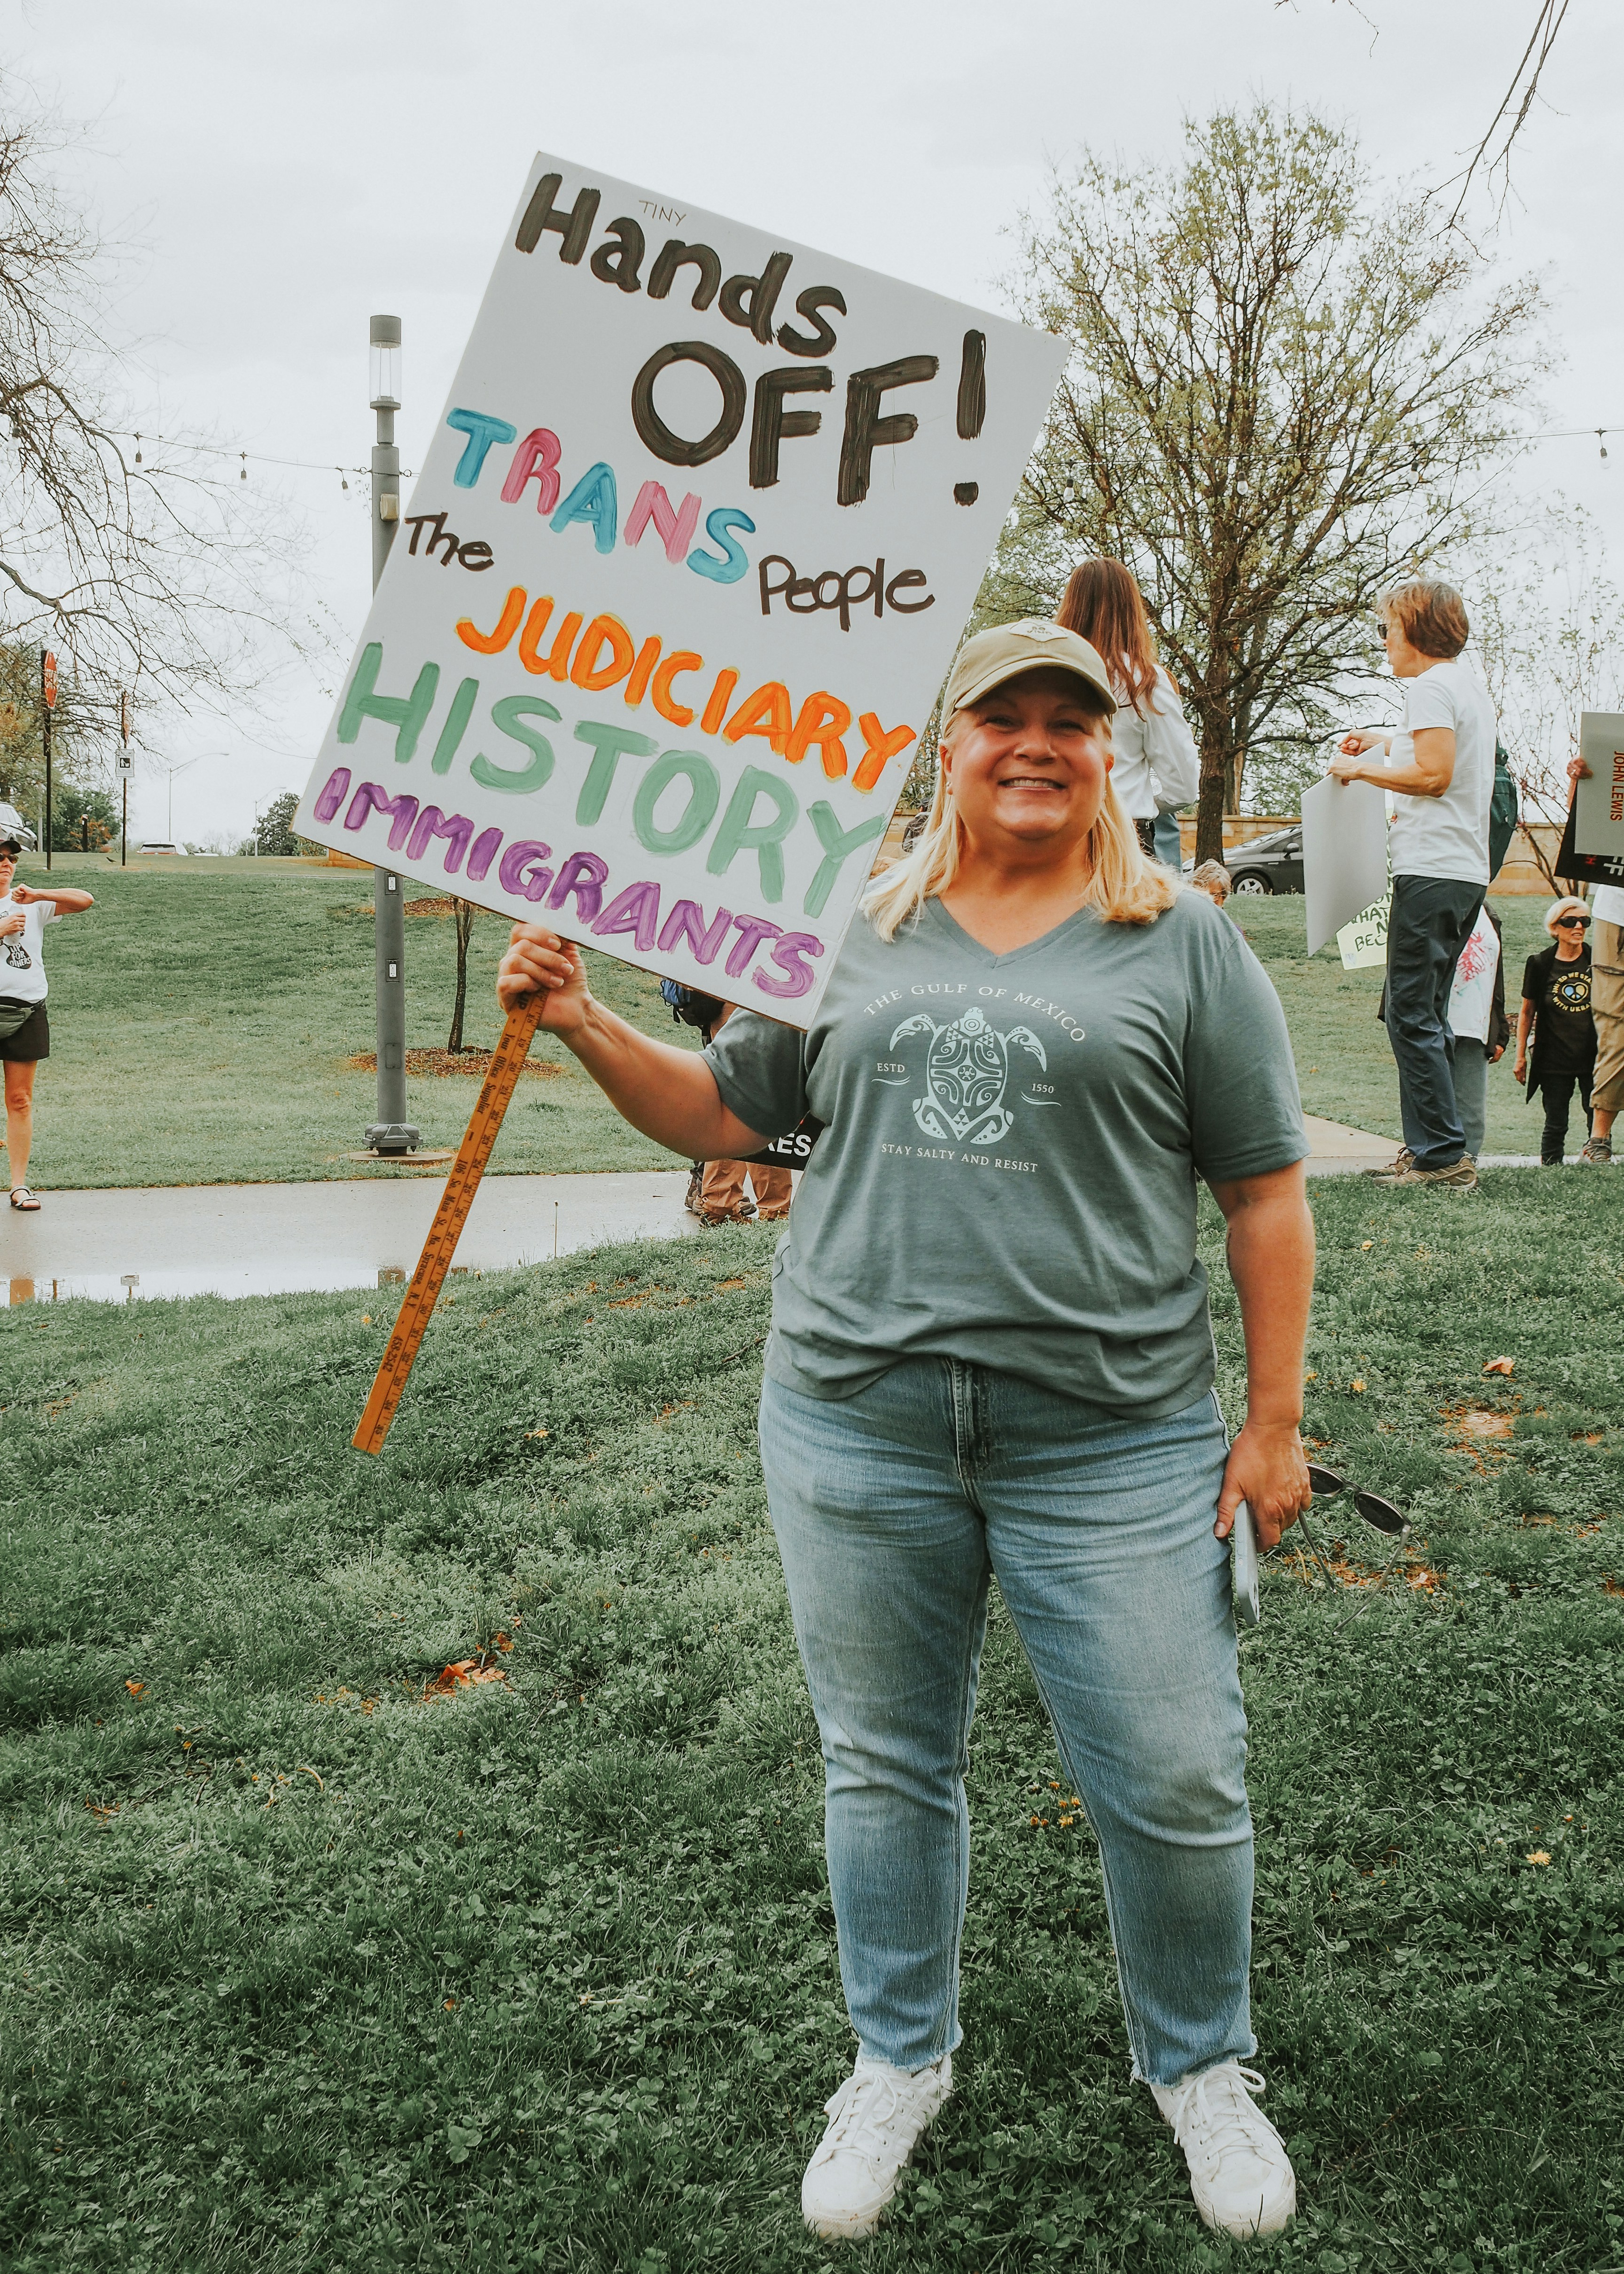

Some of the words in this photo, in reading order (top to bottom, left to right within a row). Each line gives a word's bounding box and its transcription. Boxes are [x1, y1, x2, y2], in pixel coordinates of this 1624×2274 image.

[639, 200, 687, 227] TINY
[515, 173, 847, 357] Hands
[632, 329, 986, 507] OFF!
[446, 408, 757, 584] TRANS
[759, 555, 935, 632] People
[405, 512, 494, 571] The
[456, 586, 917, 793] JUDICIARY
[337, 642, 886, 918] HISTORY
[1613, 751, 1624, 785] JOHN
[1610, 785, 1624, 821] LEWIS
[314, 767, 825, 999] IMMIGRANTS
[10, 957, 31, 968] OTHERS
[11, 951, 26, 960] FOR
[863, 989, 902, 1016] THE
[911, 983, 968, 996] GULF
[978, 986, 1007, 998] OF
[1013, 992, 1086, 1043] MEXICO
[501, 1034, 515, 1051] Your
[518, 1038, 526, 1048] 19
[491, 1056, 506, 1078] Office
[509, 1061, 517, 1072] 20
[877, 1063, 905, 1074] ESTD
[477, 1083, 496, 1114] Supplier
[1031, 1083, 1054, 1094] 1550
[455, 1160, 468, 1174] 106
[881, 1143, 912, 1155] STAY
[917, 1147, 955, 1161] SALTY
[961, 1153, 989, 1166] AND
[994, 1158, 1038, 1173] RESIST
[441, 1194, 455, 1212] Main
